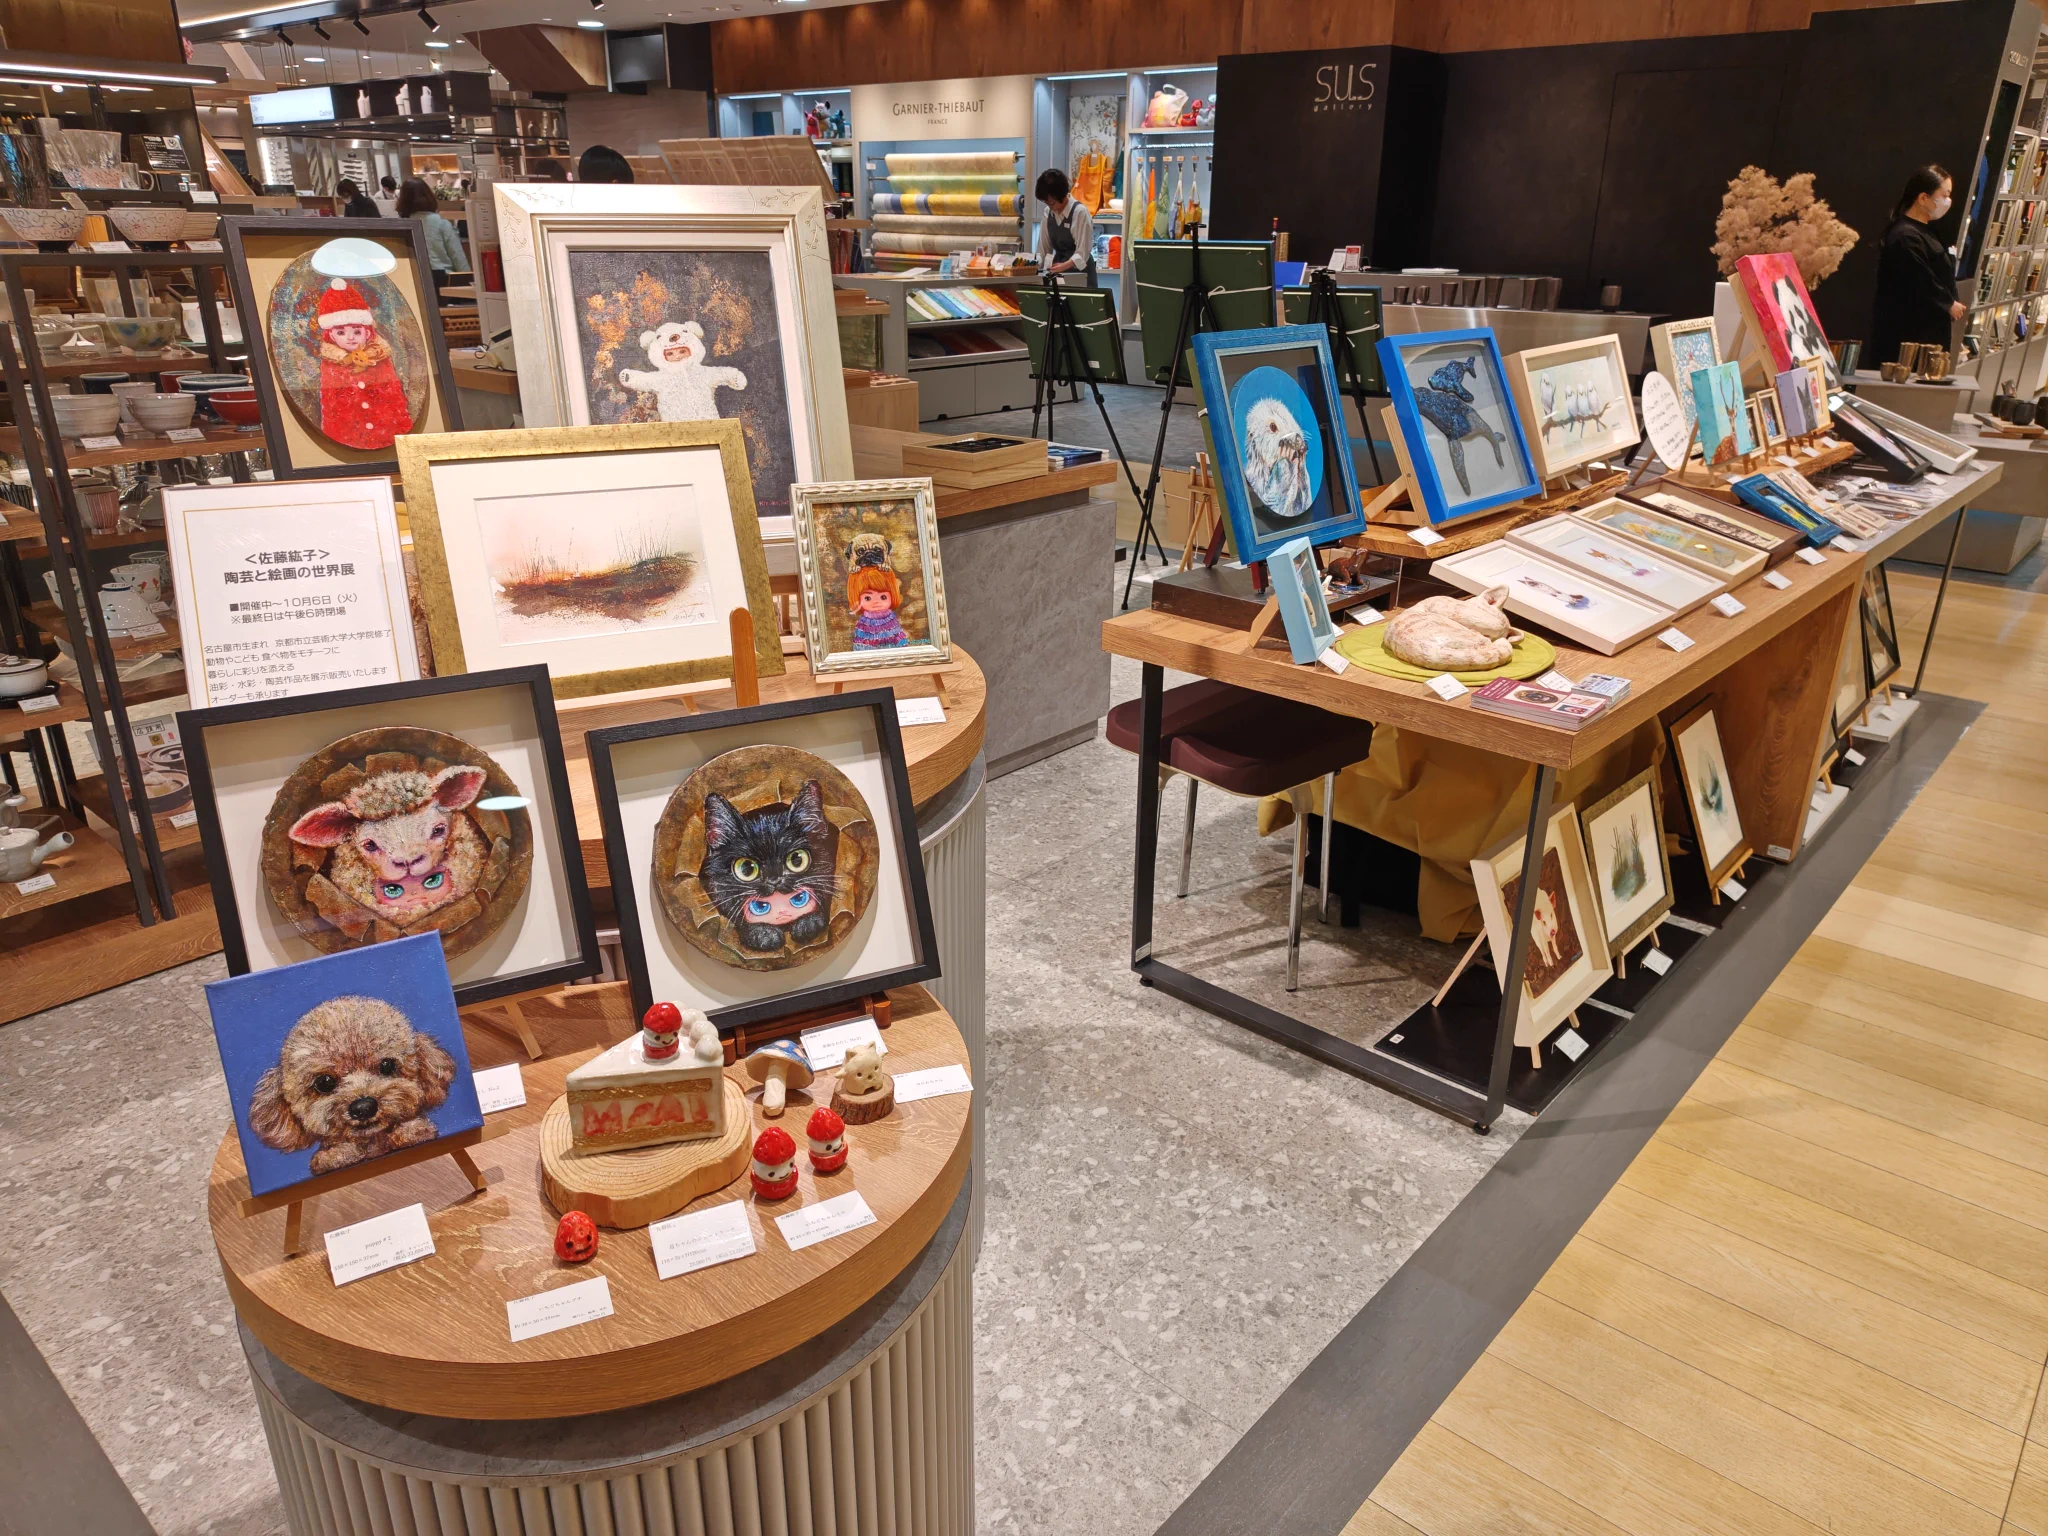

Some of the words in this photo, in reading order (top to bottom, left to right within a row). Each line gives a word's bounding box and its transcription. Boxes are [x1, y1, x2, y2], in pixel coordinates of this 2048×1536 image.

[1314, 63, 1377, 103] SUS
[892, 99, 985, 116] GARNIER-THIEBAUT
[1313, 103, 1373, 113] gallery
[224, 563, 356, 585] 陶芸と絵画の世界展
[204, 640, 269, 655] 名古屋市生まれ
[275, 629, 392, 648] 京都市立芸術大学大学院修了
[206, 653, 260, 667] 動物やこども
[261, 646, 341, 662] 食べ物をモチーフに
[207, 663, 295, 680] 暮らしに彩りを添える
[209, 666, 388, 693] 油彩・水彩・陶芸作品を展示販売いたします
[210, 688, 290, 705] オーダーも承ります
[364, 1240, 382, 1250] puppy
